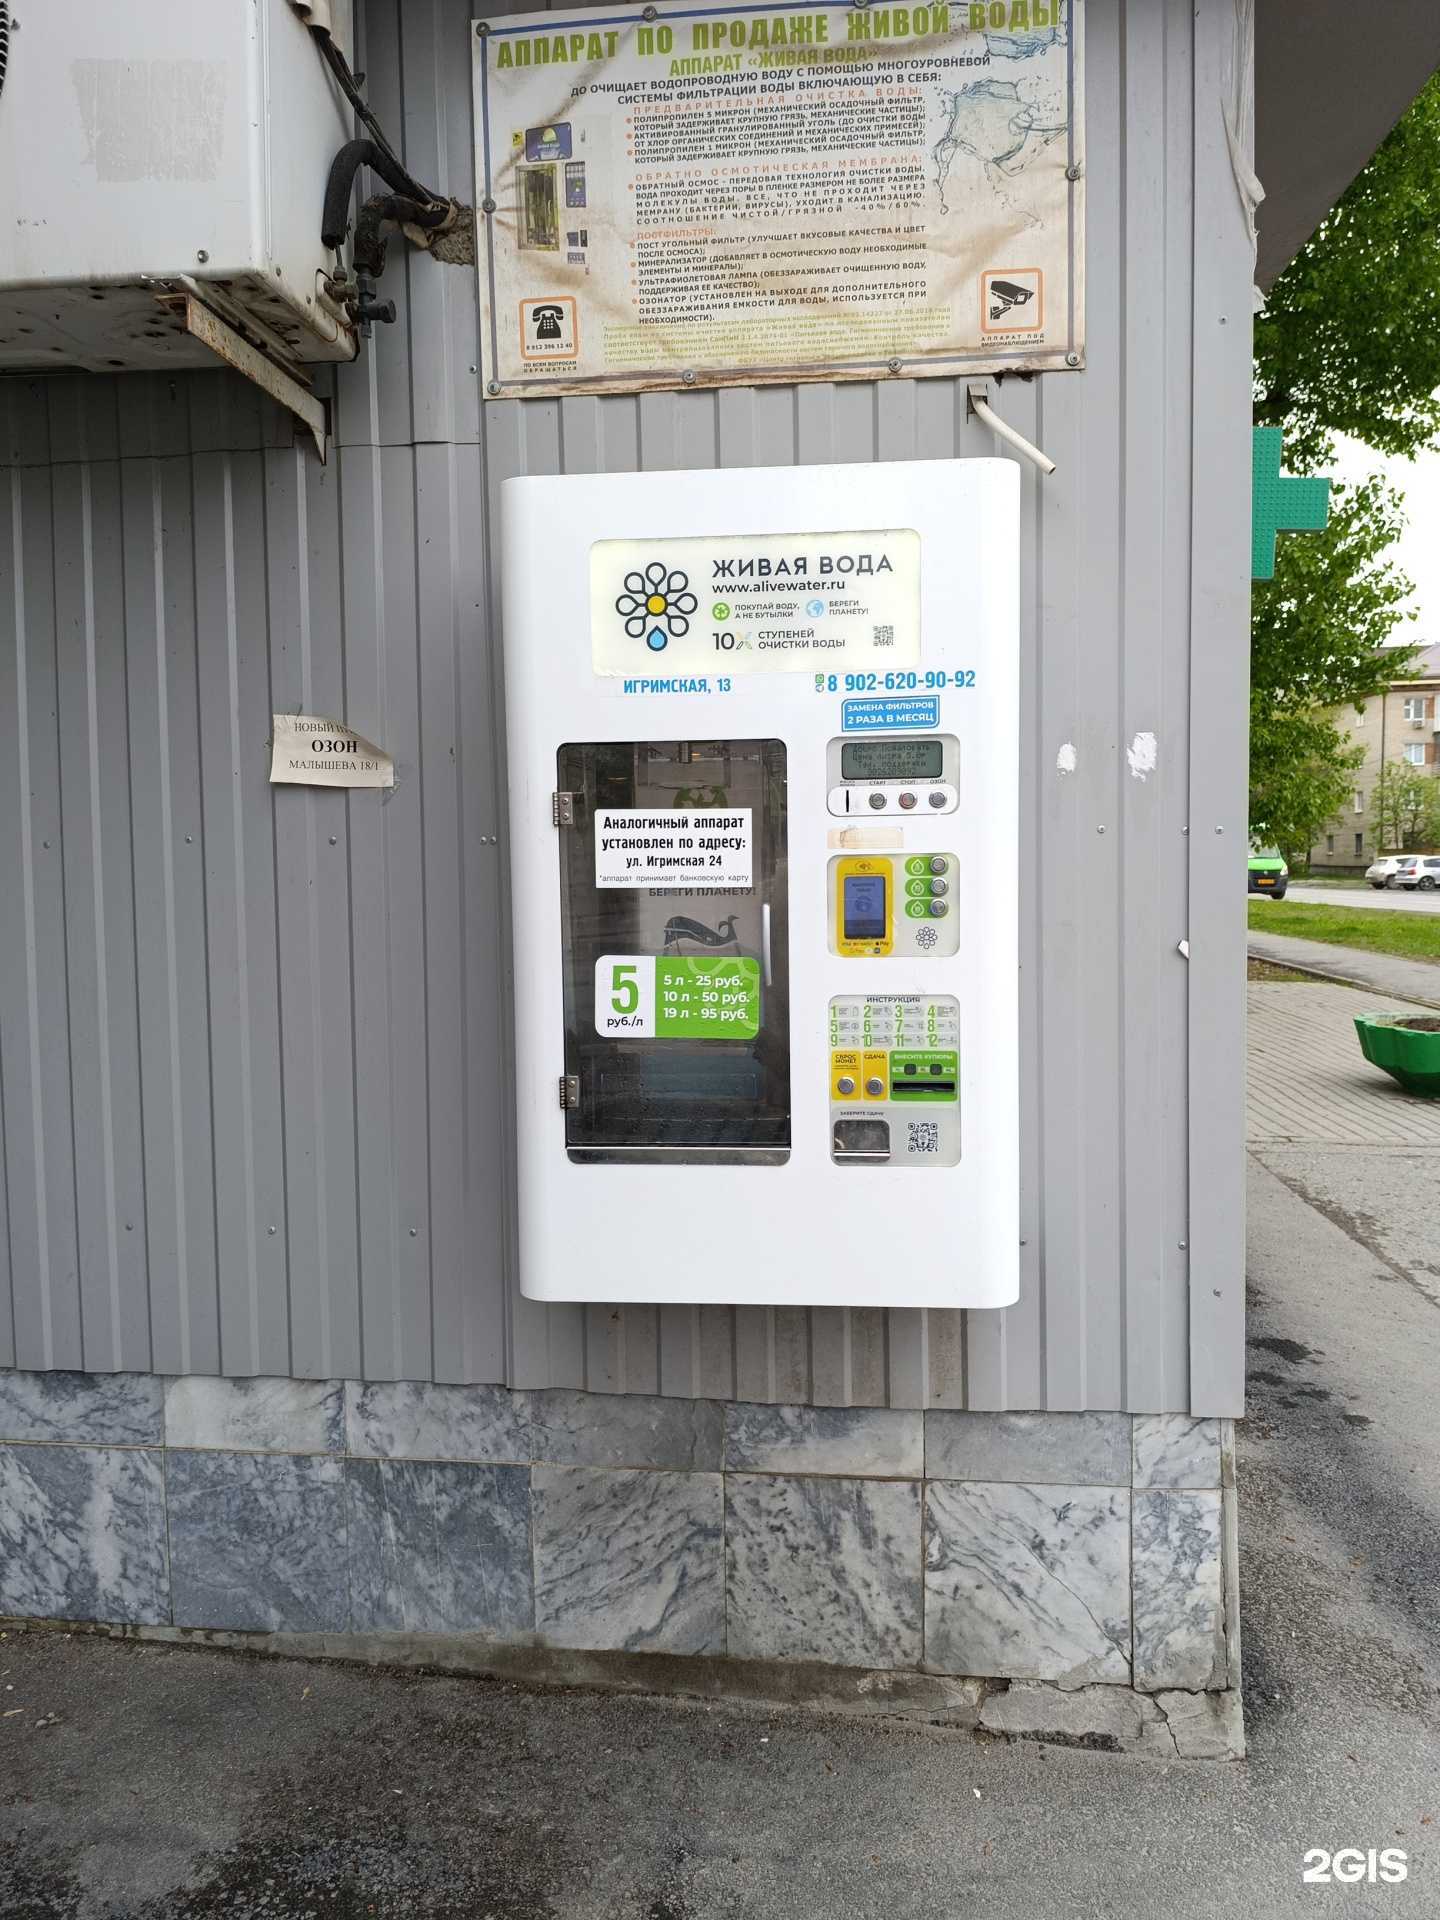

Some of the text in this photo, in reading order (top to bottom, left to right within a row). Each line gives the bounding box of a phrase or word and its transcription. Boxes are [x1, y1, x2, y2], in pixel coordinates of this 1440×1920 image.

[498, 0, 1059, 67] АППАРАТ ПО ПРОДАЖЕ ЖИВОЙ ВОДЫ
[669, 53, 741, 76] АППАРАТ
[571, 53, 990, 98] ДО ОЧИЩАЕТ ВОДОПРОВОДНУЮ ВОДУ С ПОМОЩЬЮ МНОГОУРОВНЕВОЙ
[617, 70, 941, 106] СИСТЕМЫ ФИЛЬТРАЦИИ ВОДЫ ВКЛЮЧАЮЩУЮ В СЕБЯ:
[635, 180, 684, 191] ОБРАТНЫЙ
[688, 177, 718, 187] ОСМОС
[729, 173, 781, 184] ПЕРЕДОВАЯ
[785, 168, 845, 180] ТЕХНОЛОГИЯ
[848, 165, 890, 176] ОЧИСТКИ
[636, 192, 657, 200] ВОДА
[660, 188, 702, 198] ПРОХОДИТ
[705, 187, 729, 195] ЧЕРЕЗ
[732, 185, 755, 193] ПОРЫ
[766, 182, 797, 191] ПЛЕНКЕ
[800, 179, 843, 189] РАЗМЕРОМ
[846, 178, 856, 186] НЕ
[860, 176, 885, 185] БОЛЕЕ
[888, 173, 924, 183] РАЗМЕРА
[637, 223, 924, 250] ПОСТ УГОЛЬНЫЙ ФИЛЬТР (УЛУЧШАЕТ ВКУСОВЫЕ КАЧЕСТВА И ЦВЕТ
[638, 242, 926, 267] МИНЕРАЛИЗАТОР (ДОБАВЛЯЕТ В ОСМОТИЧЕСКУЮ ВОДУ НЕОБХОДИМЫЕ
[639, 280, 926, 304] ОЗОНАТОР (УСТАНОВЛЕН НА ВЫХОДЕ ДЛЯ ДОПОЛНИТЕЛЬНОГО
[712, 554, 894, 578] ЖИВАЯ ВОДА
[712, 578, 845, 593] www.alivewater.ru
[735, 602, 799, 612] ПОКУПАЙ ВОДУ,
[829, 600, 860, 608] БЕРЕГИ
[829, 607, 869, 615] ПЛАНЕТУ!
[758, 628, 815, 639] СТУПЕНЕЙ
[712, 632, 735, 650] 10
[758, 638, 845, 650] ОЧИСТКИ ВОДЫ
[623, 678, 731, 694] ИГРИМСКАЯ, 13
[827, 670, 976, 692] 8 902-620-90-92
[847, 701, 934, 712] ЗАМЕНА ФИЛЬТРОВ
[847, 713, 934, 724] 2 РАЗА В МЕСЯЦ
[312, 740, 358, 752] ОЗОН
[289, 760, 378, 770] МАЛЫШЕВА 18/1
[603, 816, 744, 829] Аналогичный аппарат
[602, 838, 746, 851] установлен по адресу:
[626, 855, 722, 868] ул. Игримская 24
[636, 875, 676, 883] принимает
[680, 874, 725, 883] банковскую
[728, 875, 749, 883] карту
[649, 888, 694, 896] БЕРЕГИ
[664, 976, 671, 986] 5
[674, 978, 683, 986] л
[696, 976, 712, 986] 25
[715, 975, 743, 988] руб.
[611, 965, 639, 1014] 5
[664, 992, 677, 1002] 10
[680, 994, 690, 1002] л
[702, 992, 718, 1002] 50
[722, 991, 750, 1005] руб.
[664, 1008, 677, 1018] 19
[701, 1008, 717, 1018] 95
[721, 1008, 749, 1021] руб.
[830, 1005, 836, 1018] 1
[864, 1005, 871, 1018] 2
[895, 1005, 903, 1018] 3
[927, 1005, 936, 1018] 4
[607, 1016, 643, 1028] руб./л
[830, 1020, 838, 1032] 5
[864, 1020, 871, 1032] 6
[895, 1020, 903, 1032] 7
[928, 1020, 935, 1032] 8
[830, 1034, 838, 1047] 9
[862, 1034, 872, 1047] 10
[894, 1034, 904, 1047] 11
[926, 1034, 937, 1047] 12
